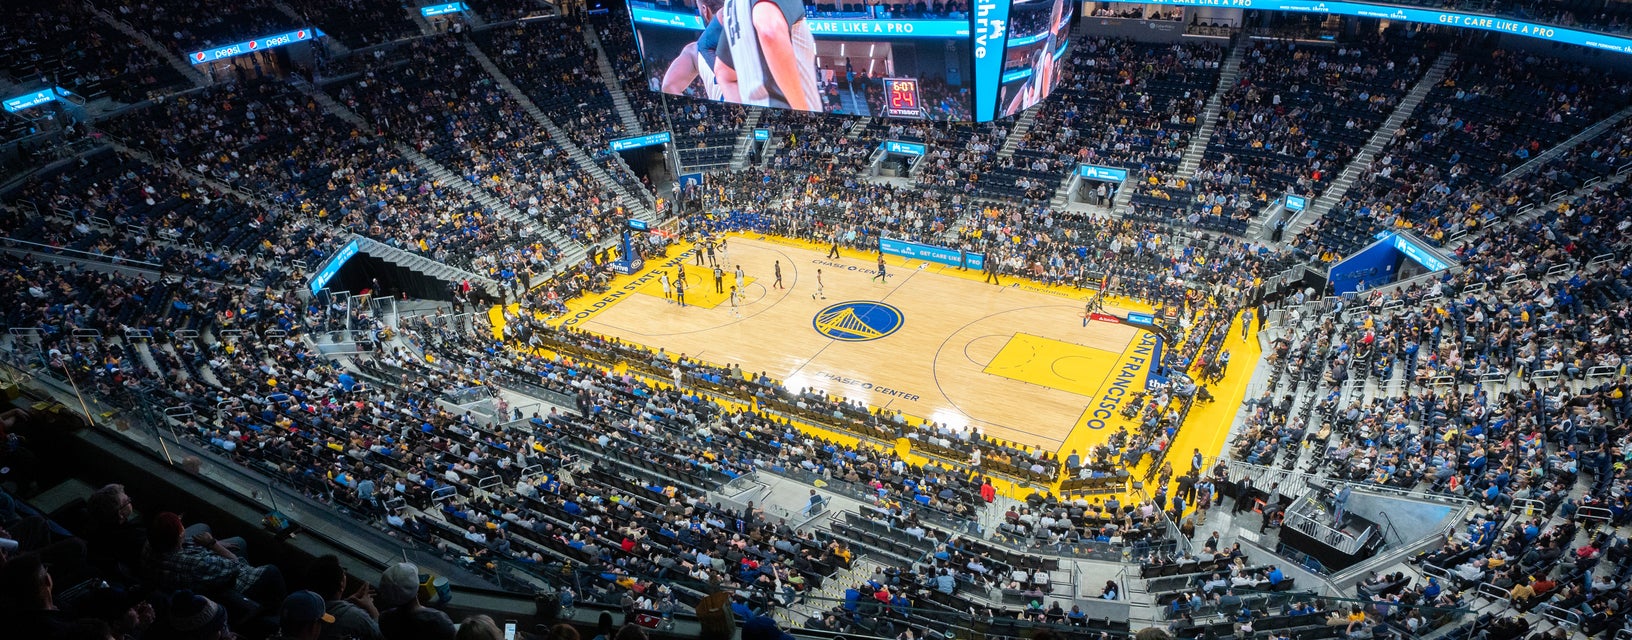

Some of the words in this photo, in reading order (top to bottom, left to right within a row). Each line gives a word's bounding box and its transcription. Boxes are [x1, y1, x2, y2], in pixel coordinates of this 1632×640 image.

[809, 22, 838, 32] CARE
[843, 22, 868, 32] LIKE
[874, 23, 882, 32] A
[888, 23, 913, 33] PRO
[975, 0, 996, 58] hrive
[1439, 15, 1460, 24] GET
[1464, 17, 1492, 27] CARE
[1496, 22, 1518, 32] LIKE
[1521, 25, 1528, 33] A
[1533, 26, 1554, 37] PRO
[266, 34, 290, 47] pepsi
[215, 45, 240, 59] pepsi
[894, 82, 914, 91] 6:07
[893, 91, 914, 107] 24
[812, 259, 848, 269] CHASE
[564, 290, 626, 325] GOLDEN
[624, 269, 662, 291] STATE
[661, 248, 696, 268] WARR
[1134, 332, 1157, 355] SAN
[816, 371, 859, 385] CHASE
[875, 386, 920, 401] CENTER
[1149, 379, 1166, 388] thr
[1087, 356, 1145, 429] FRANCISCO
